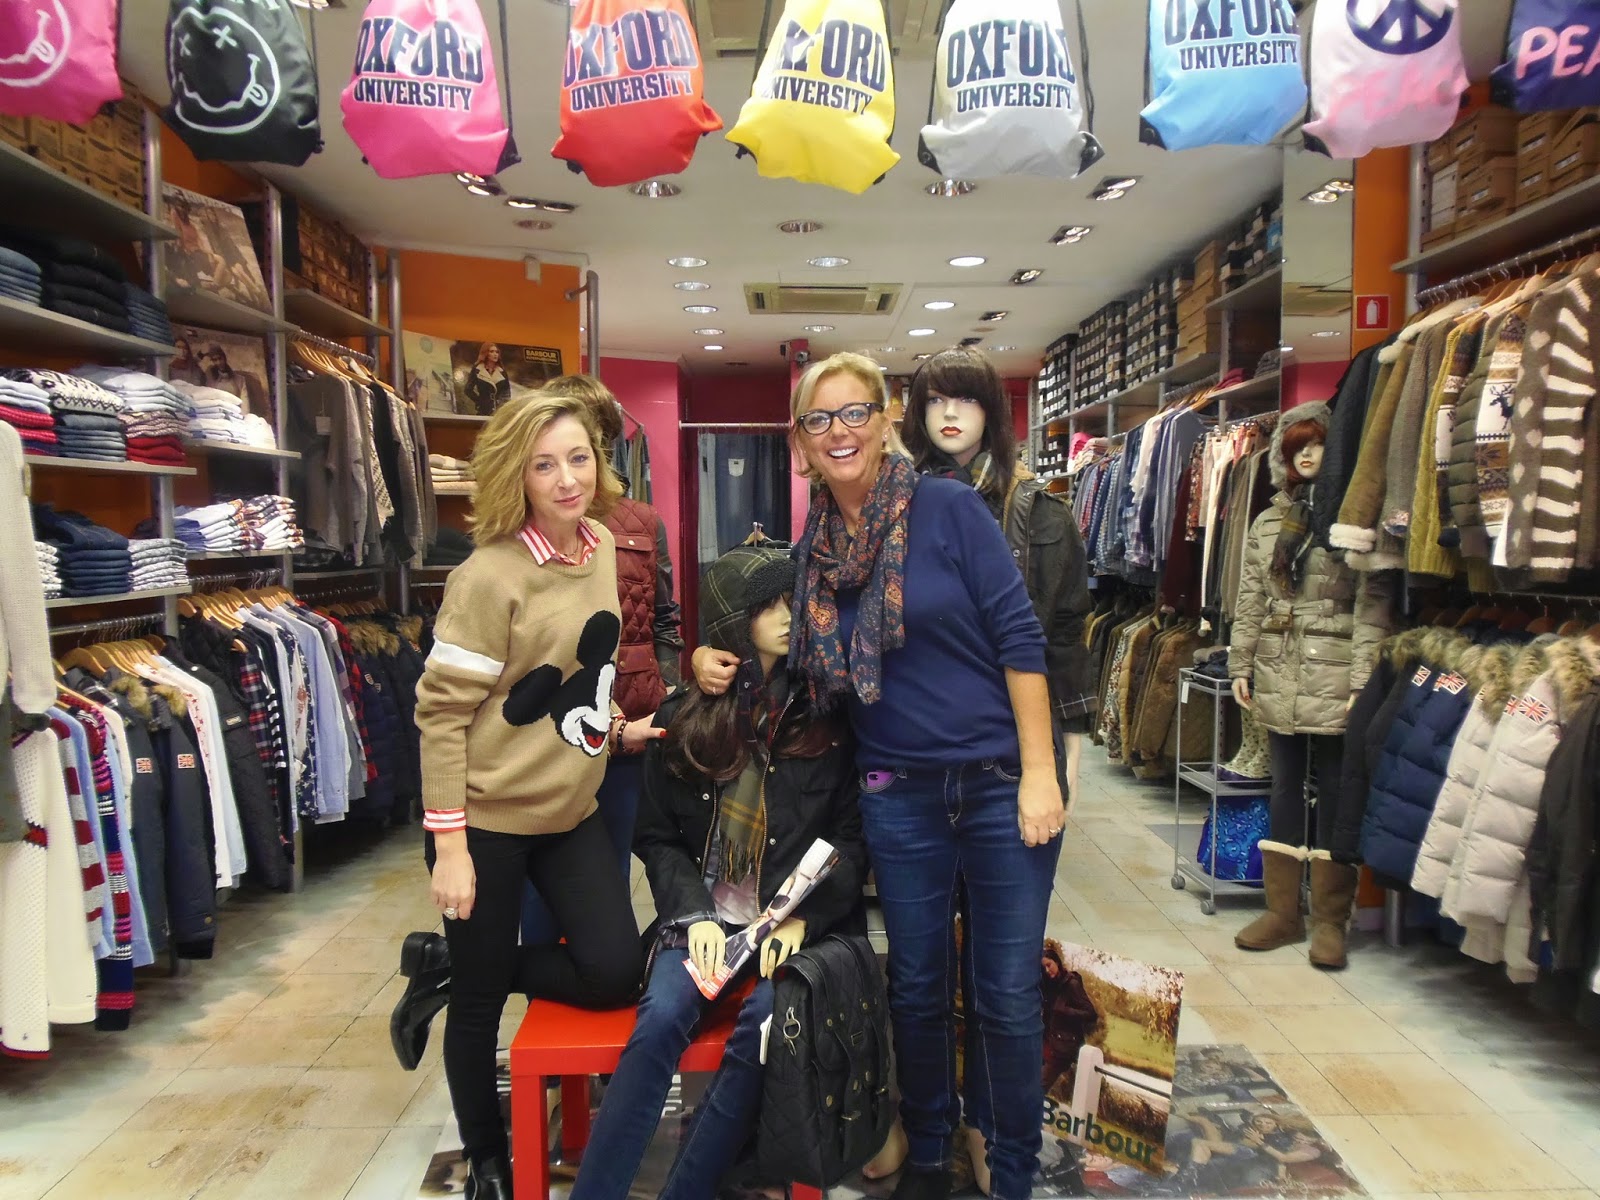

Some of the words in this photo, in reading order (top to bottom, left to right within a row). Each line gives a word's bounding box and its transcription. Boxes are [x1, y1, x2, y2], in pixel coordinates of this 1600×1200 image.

[1164, 0, 1300, 46] OXFOR
[354, 17, 485, 84] OXFORD
[563, 9, 699, 88] OXFORD
[1180, 40, 1298, 71] UNIVERSITY
[354, 77, 473, 112] UNIVERSITY
[571, 71, 693, 112] UNIVERSITY
[957, 82, 1072, 113] UNIVERSITY
